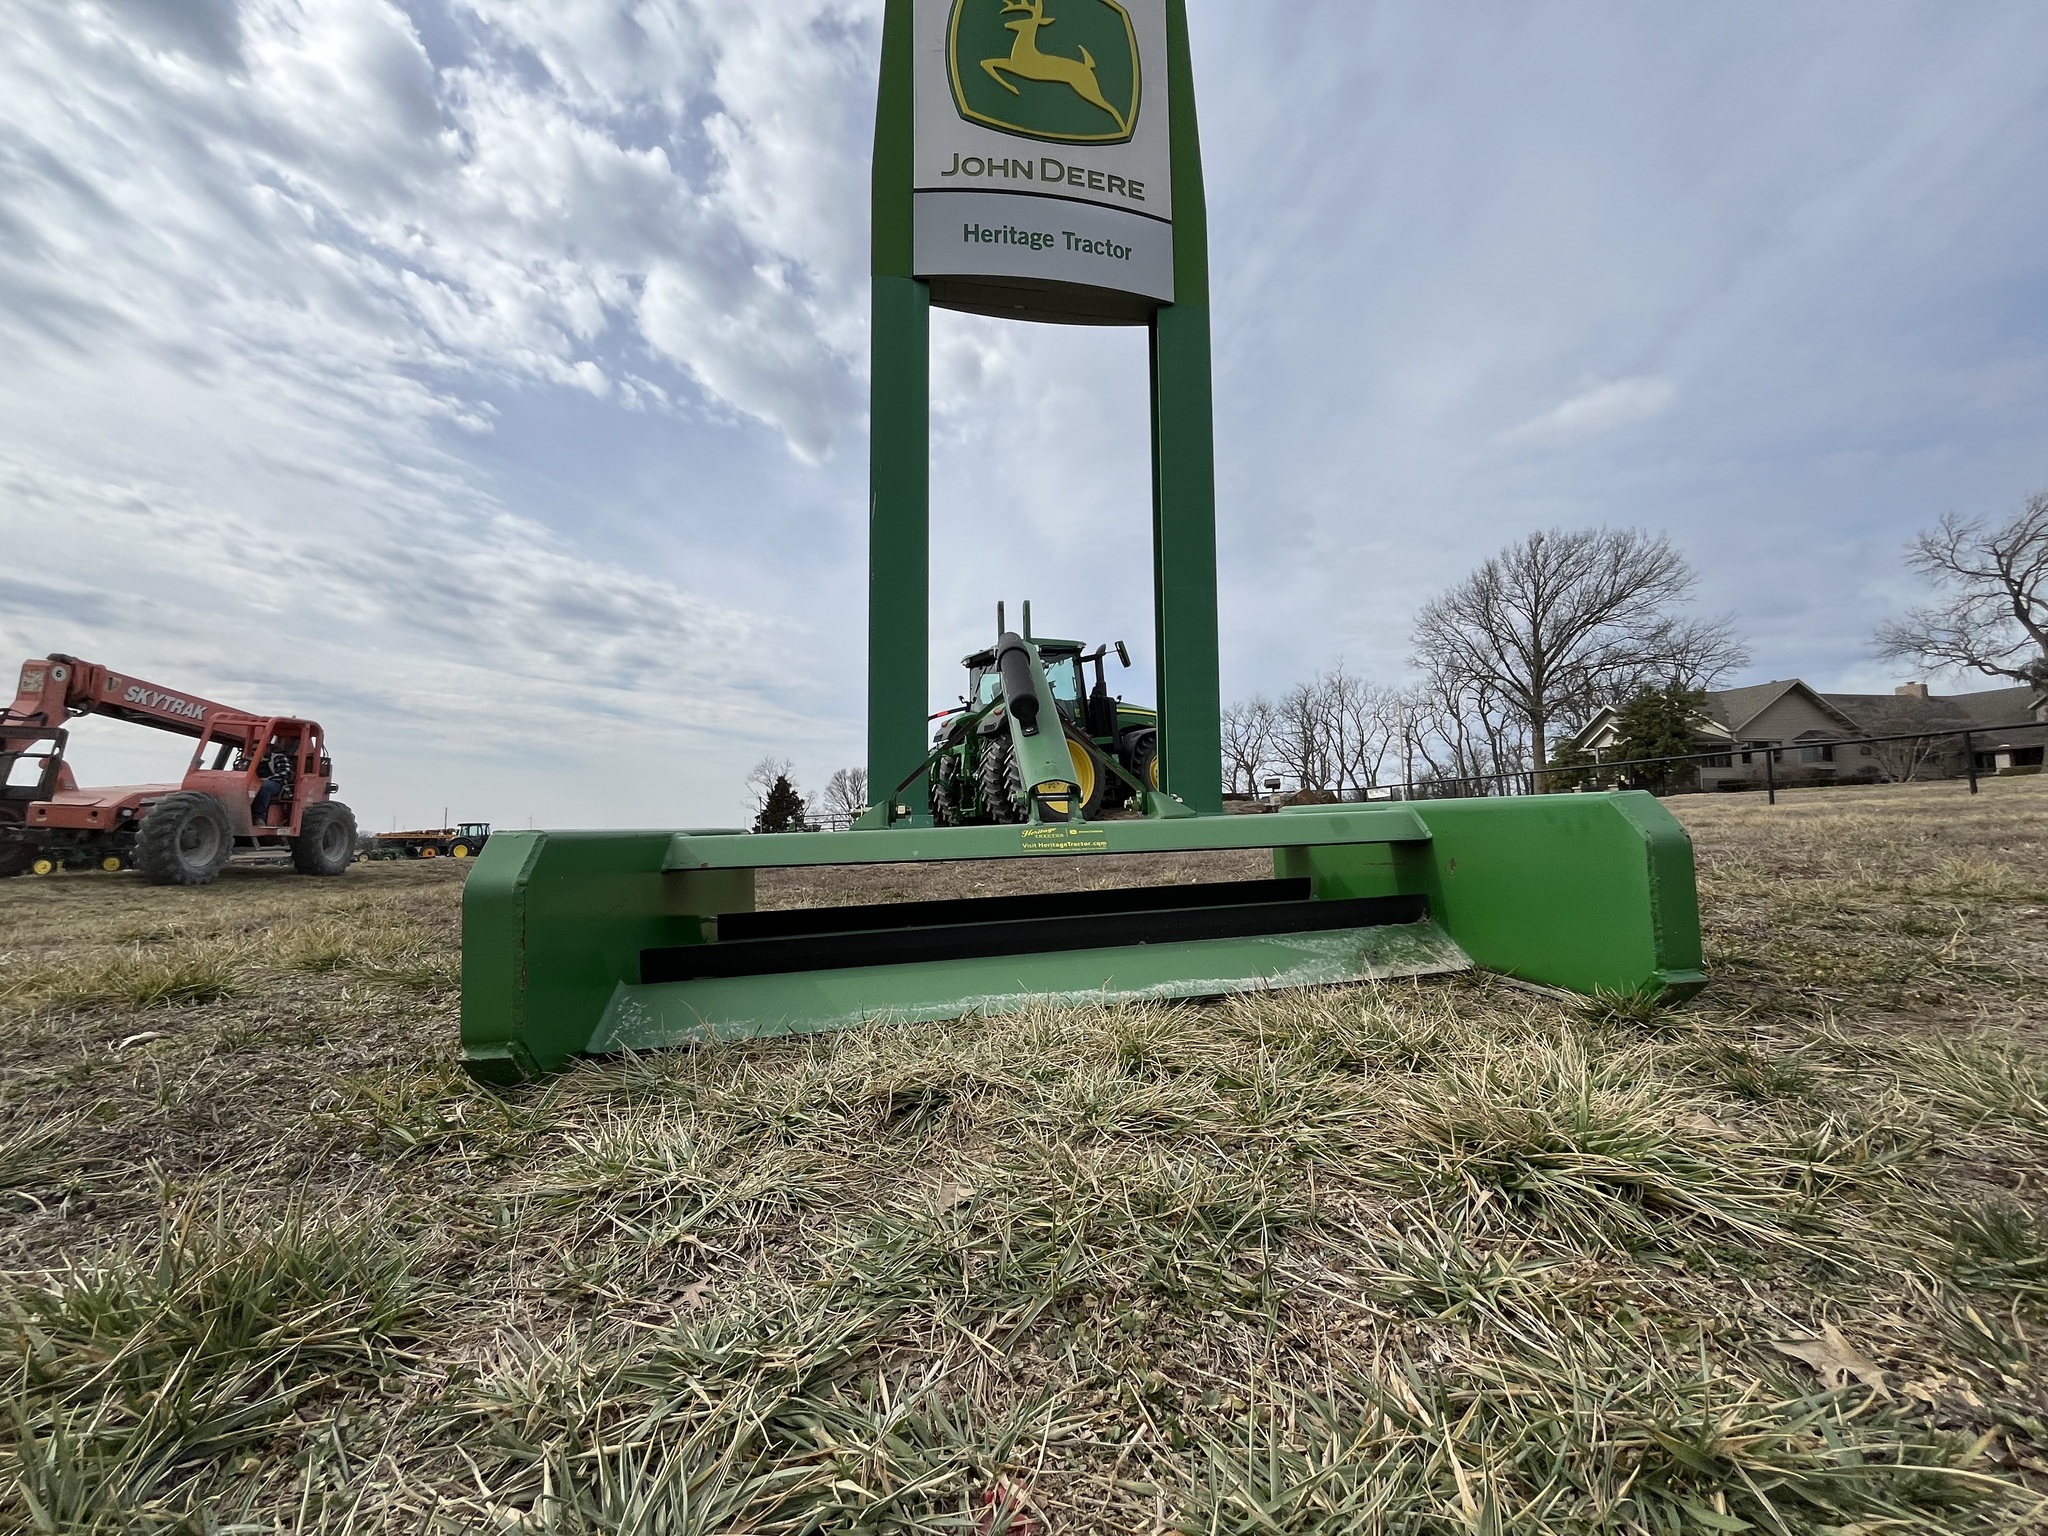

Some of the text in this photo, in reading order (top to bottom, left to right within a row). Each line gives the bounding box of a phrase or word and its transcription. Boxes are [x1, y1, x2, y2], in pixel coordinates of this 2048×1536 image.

[940, 153, 1145, 201] JOHN DEERE
[963, 223, 1132, 261] Heritage Tractor
[55, 669, 62, 678] 6
[124, 685, 208, 720] SKYTRAK
[1038, 841, 1107, 849] HeritageTractor.com
